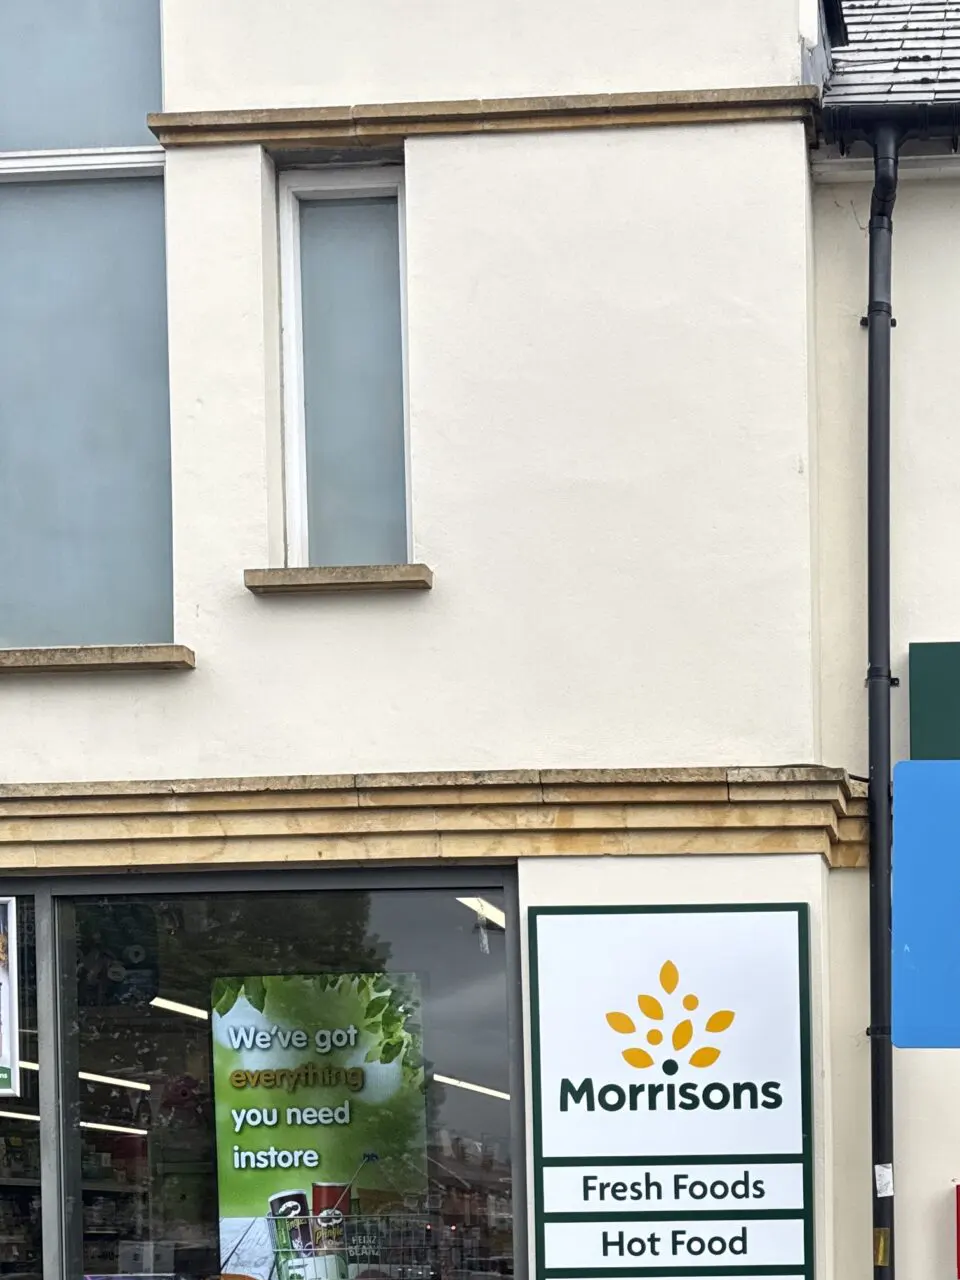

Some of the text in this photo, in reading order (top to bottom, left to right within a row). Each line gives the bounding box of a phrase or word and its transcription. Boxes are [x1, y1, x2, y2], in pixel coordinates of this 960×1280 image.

[228, 1024, 358, 1054] We've got
[229, 1062, 365, 1093] everything
[559, 1076, 783, 1112] Morrisons
[231, 1100, 351, 1133] you need
[233, 1145, 320, 1169] instore
[582, 1170, 766, 1202] Fresh Foods
[352, 1235, 377, 1245] HEINZ
[601, 1226, 748, 1257] Hot Food
